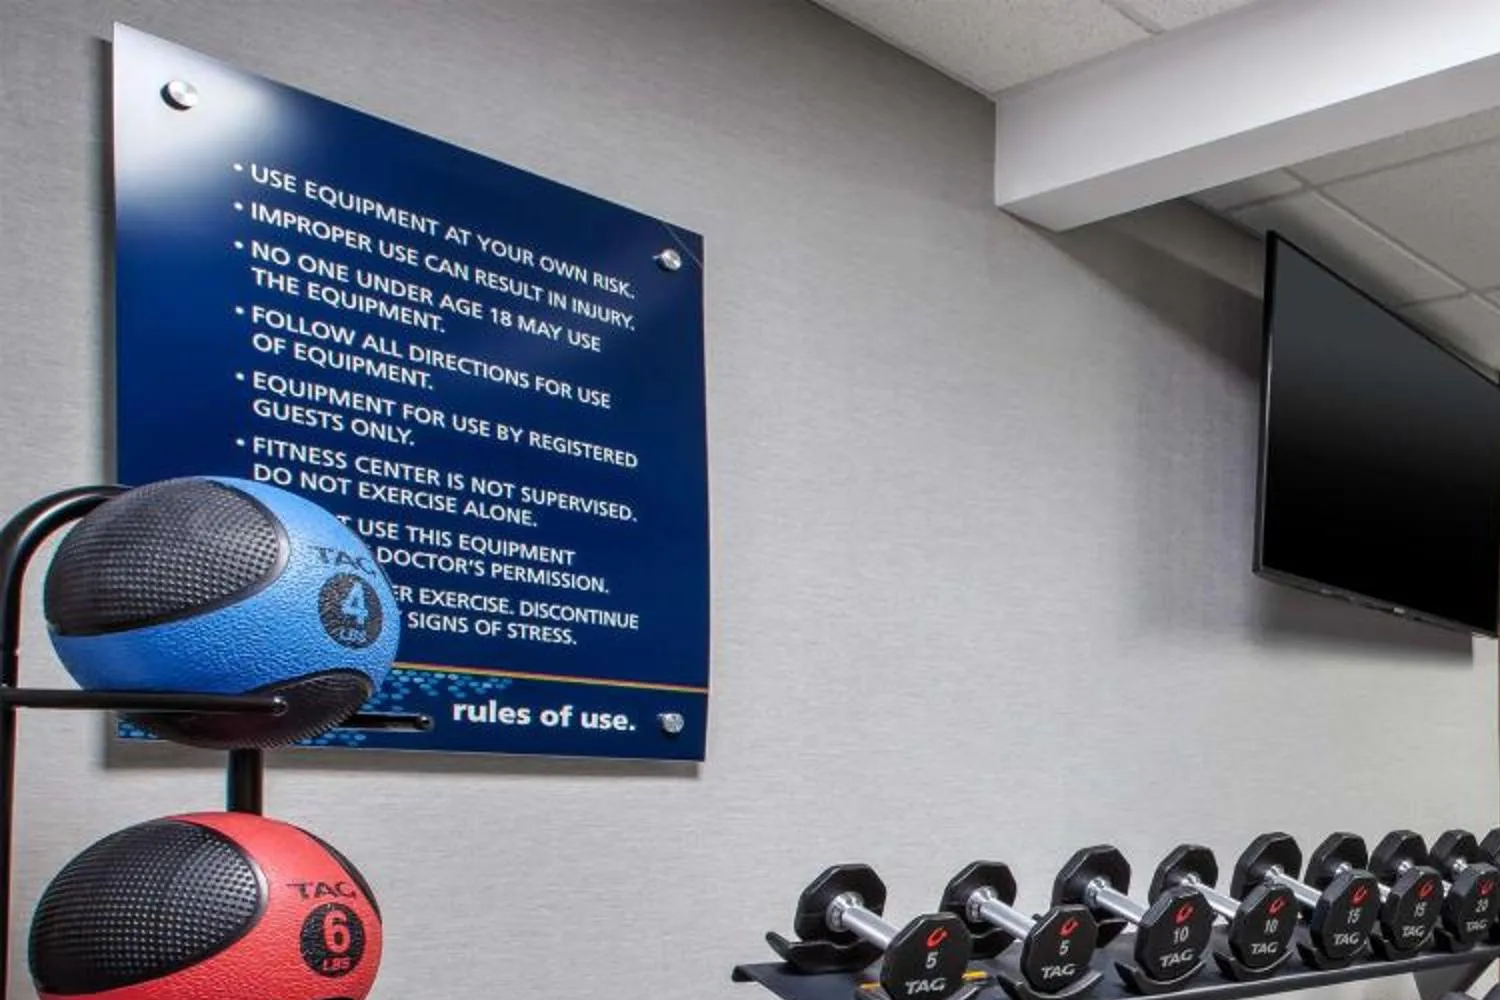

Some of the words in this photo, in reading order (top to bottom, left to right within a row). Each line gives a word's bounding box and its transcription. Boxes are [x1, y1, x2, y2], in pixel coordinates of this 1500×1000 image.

[252, 164, 296, 192] USE
[305, 180, 438, 236] EQUIPMENT
[445, 226, 471, 245] AT
[477, 235, 534, 266] YOUR
[540, 256, 587, 283] OWN
[594, 272, 634, 299] RISK.
[251, 202, 372, 252] IMPROPER
[379, 240, 417, 265] USE
[425, 255, 468, 280] CAN
[475, 269, 543, 301] RESULT
[549, 291, 566, 309] IN
[572, 298, 634, 330] INJURY.
[251, 267, 299, 295] THE
[308, 281, 446, 333] EQUIPMENT.
[252, 240, 290, 265] NO
[298, 255, 348, 282] ONE
[357, 270, 434, 304] UNDER
[440, 294, 482, 319] AGE
[491, 308, 512, 326] 18
[518, 315, 562, 340] MAY
[568, 329, 600, 352] USE
[252, 306, 355, 348] FOLLOW
[362, 334, 402, 358] ALL
[410, 345, 529, 389] DIRECTIONS
[536, 376, 572, 398] FOR
[578, 387, 610, 408] USE
[253, 333, 285, 354] OF
[294, 342, 434, 391] EQUIPMENT.
[253, 373, 398, 418] EQUIPMENT
[403, 404, 444, 427] FOR
[453, 415, 490, 436] USE
[497, 424, 523, 442] BY
[530, 431, 637, 467] REGISTERED
[253, 399, 343, 431] GUESTS
[351, 419, 414, 445] ONLY.
[254, 437, 348, 470] FITNESS
[355, 456, 440, 485] CENTER
[448, 473, 464, 490] IS
[472, 477, 515, 498] NOT
[521, 487, 637, 522] SUPERVISED.
[254, 464, 291, 485] DO
[301, 471, 351, 494] NOT
[358, 482, 457, 513] EXERCISE
[464, 501, 536, 526] ALONE.
[358, 519, 398, 539] USE
[406, 525, 452, 547] THIS
[459, 534, 575, 564] EQUIPMENT
[377, 546, 484, 576] DOCTOR'S
[492, 563, 608, 593] PERMISSION.
[340, 580, 369, 625] 4
[420, 588, 514, 614] EXERCISE.
[520, 601, 638, 630] DISCONTINUE
[408, 612, 468, 633] SIGNS
[475, 620, 501, 636] OF
[508, 623, 576, 644] STRESS.
[453, 700, 530, 724] rules
[540, 705, 572, 726] of
[581, 712, 635, 730] use.
[285, 881, 357, 899] TAG
[1348, 908, 1361, 924] 15
[1414, 901, 1427, 917] 15
[1466, 918, 1488, 931] TAG
[323, 909, 351, 954] 6
[1059, 939, 1069, 955] 5
[1173, 926, 1189, 943] 10
[1251, 941, 1279, 954] TAG
[1333, 932, 1360, 946] TAG
[1402, 925, 1426, 937] TAG
[925, 952, 937, 968] 5
[1040, 963, 1076, 980] TAG
[1159, 949, 1193, 968] TAG
[905, 977, 946, 994] TAG
